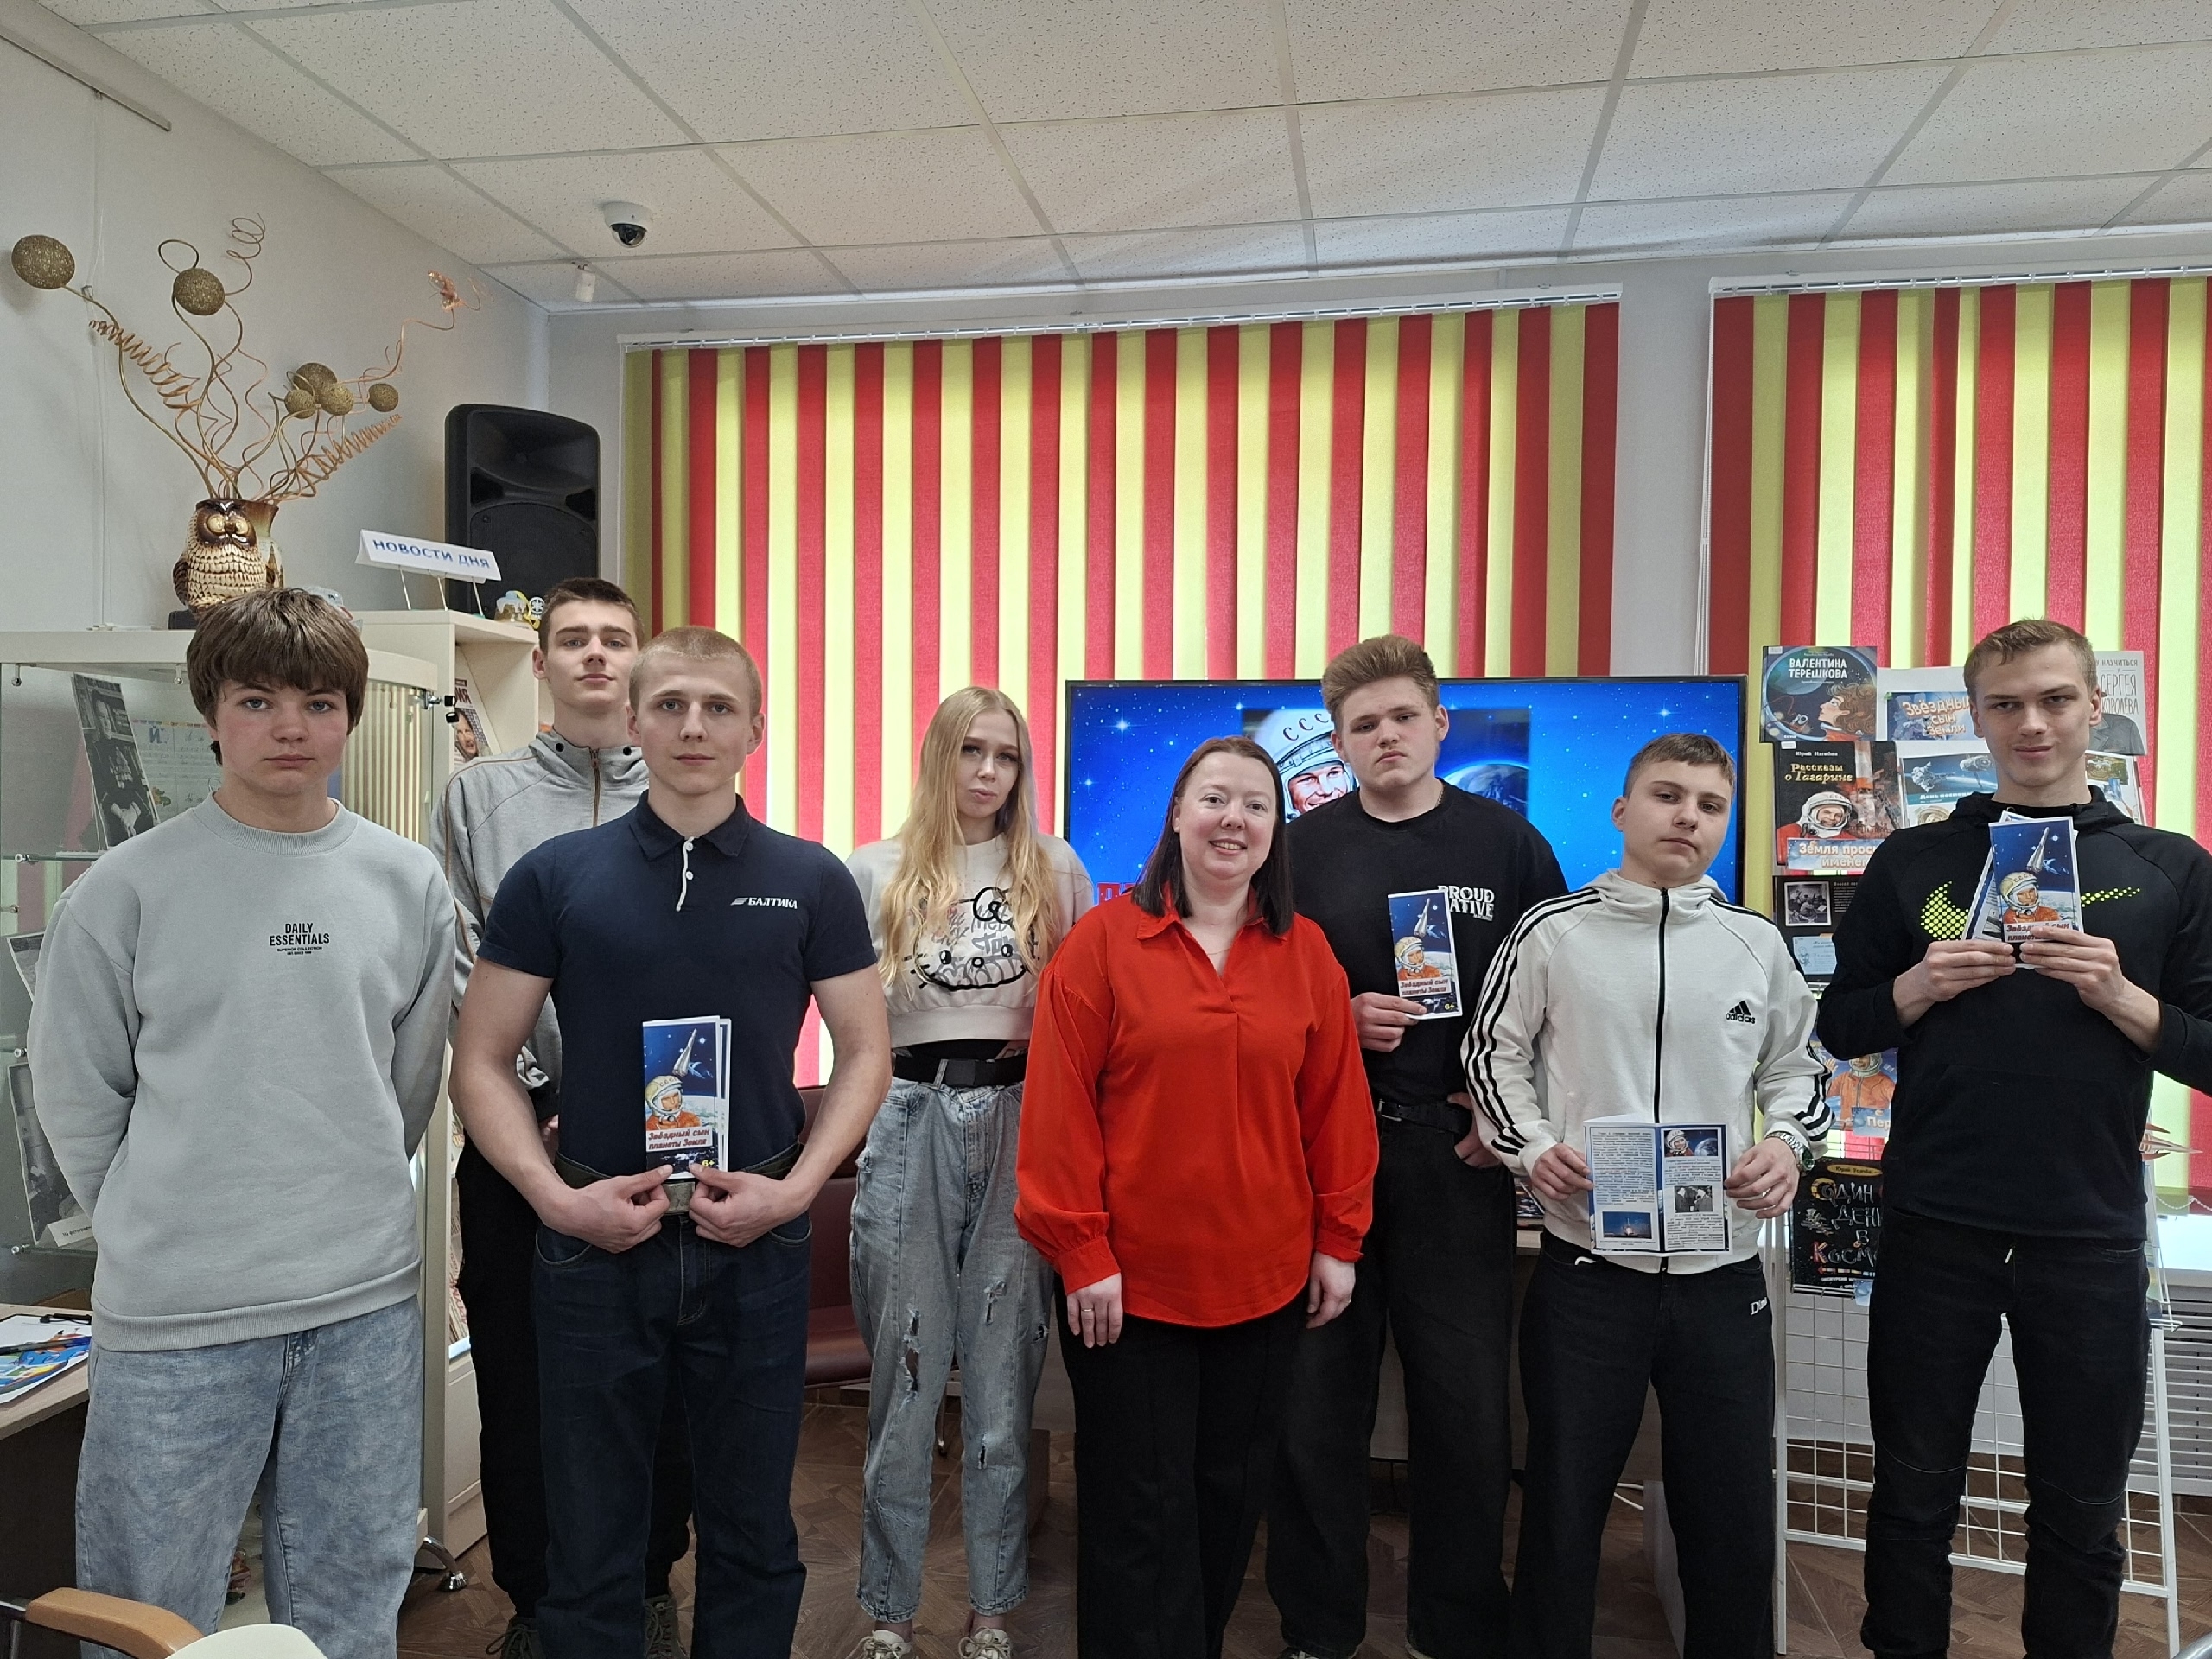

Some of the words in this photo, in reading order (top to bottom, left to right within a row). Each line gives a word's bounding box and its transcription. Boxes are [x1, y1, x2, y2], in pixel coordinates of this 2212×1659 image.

[372, 539, 454, 562] НОВОСТИ
[458, 554, 490, 569] ДНЯ
[1789, 658, 1847, 668] ВАЛЕНТИНА
[1789, 668, 1848, 679] ТЕРЕШКОВА
[2101, 674, 2137, 696] СЕРГЕЯ
[1282, 713, 1330, 741] ССС
[1927, 725, 1967, 736] Земли
[1790, 763, 1843, 773] Рассказы
[1795, 771, 1853, 785] Гагарине
[1799, 842, 1839, 855] Земля
[747, 897, 798, 910] БАЛТИКА
[1449, 899, 1494, 918] ATIVE
[284, 922, 314, 934] DAILY
[269, 932, 330, 946] ESSENTIALS
[1726, 1012, 1756, 1025] adidas
[1813, 1241, 1878, 1268] КОСМ
